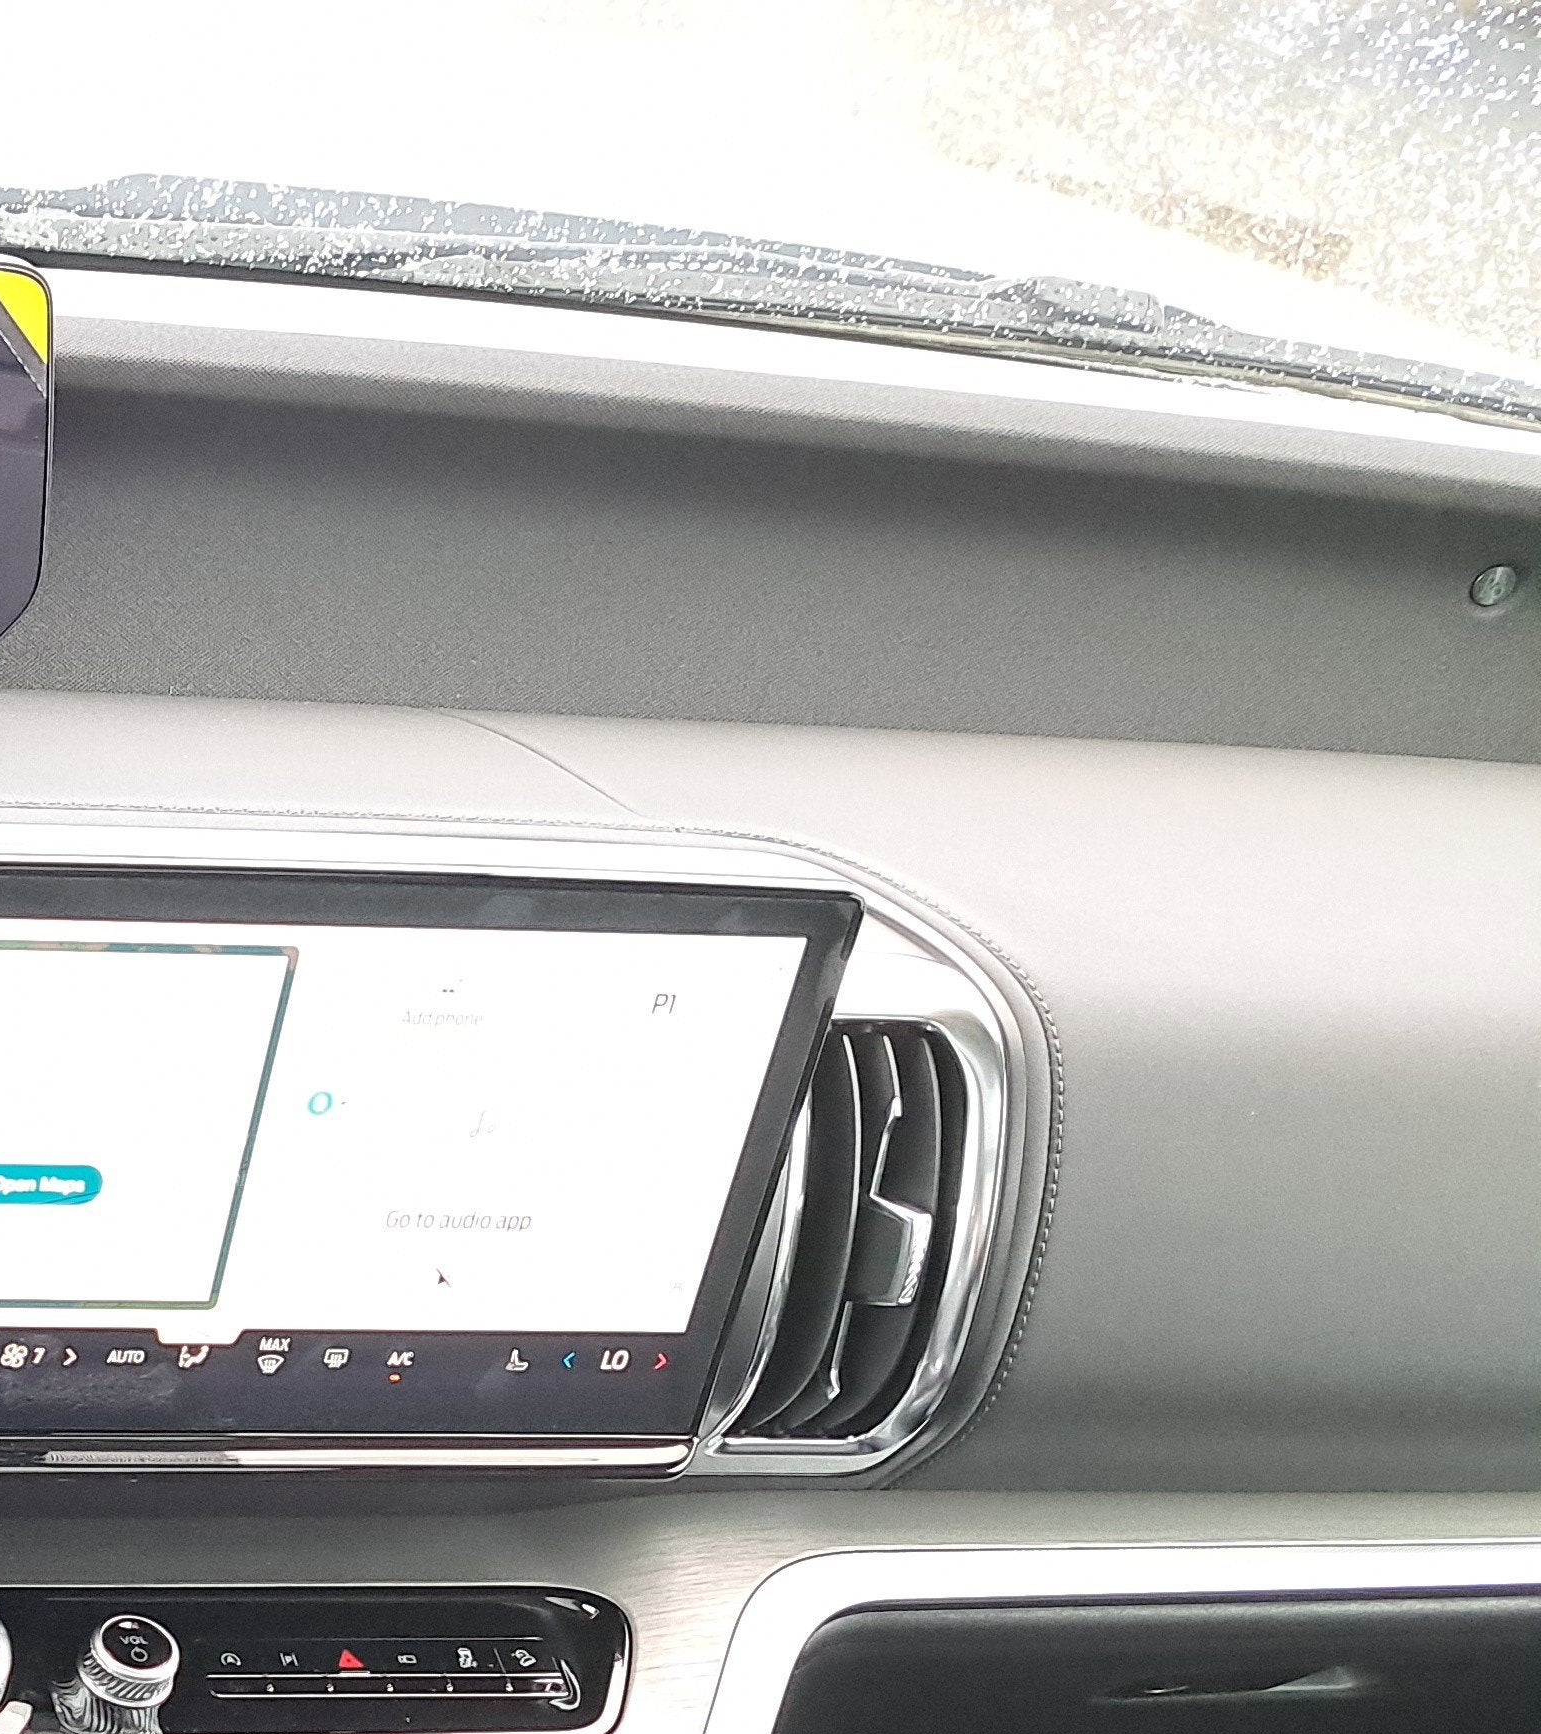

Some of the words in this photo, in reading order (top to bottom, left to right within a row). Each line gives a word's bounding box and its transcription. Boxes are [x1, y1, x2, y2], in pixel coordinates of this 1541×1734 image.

[38, 1176, 86, 1195] Maps
[386, 1209, 411, 1229] Go
[416, 1211, 436, 1229] to
[440, 1210, 491, 1229] audio
[495, 1213, 533, 1233] app
[258, 1336, 291, 1352] MAX
[31, 1346, 46, 1364] 7
[106, 1349, 147, 1366] AUTO
[387, 1350, 414, 1367] A/C
[600, 1349, 630, 1371] LO
[119, 1634, 149, 1646] VOL
